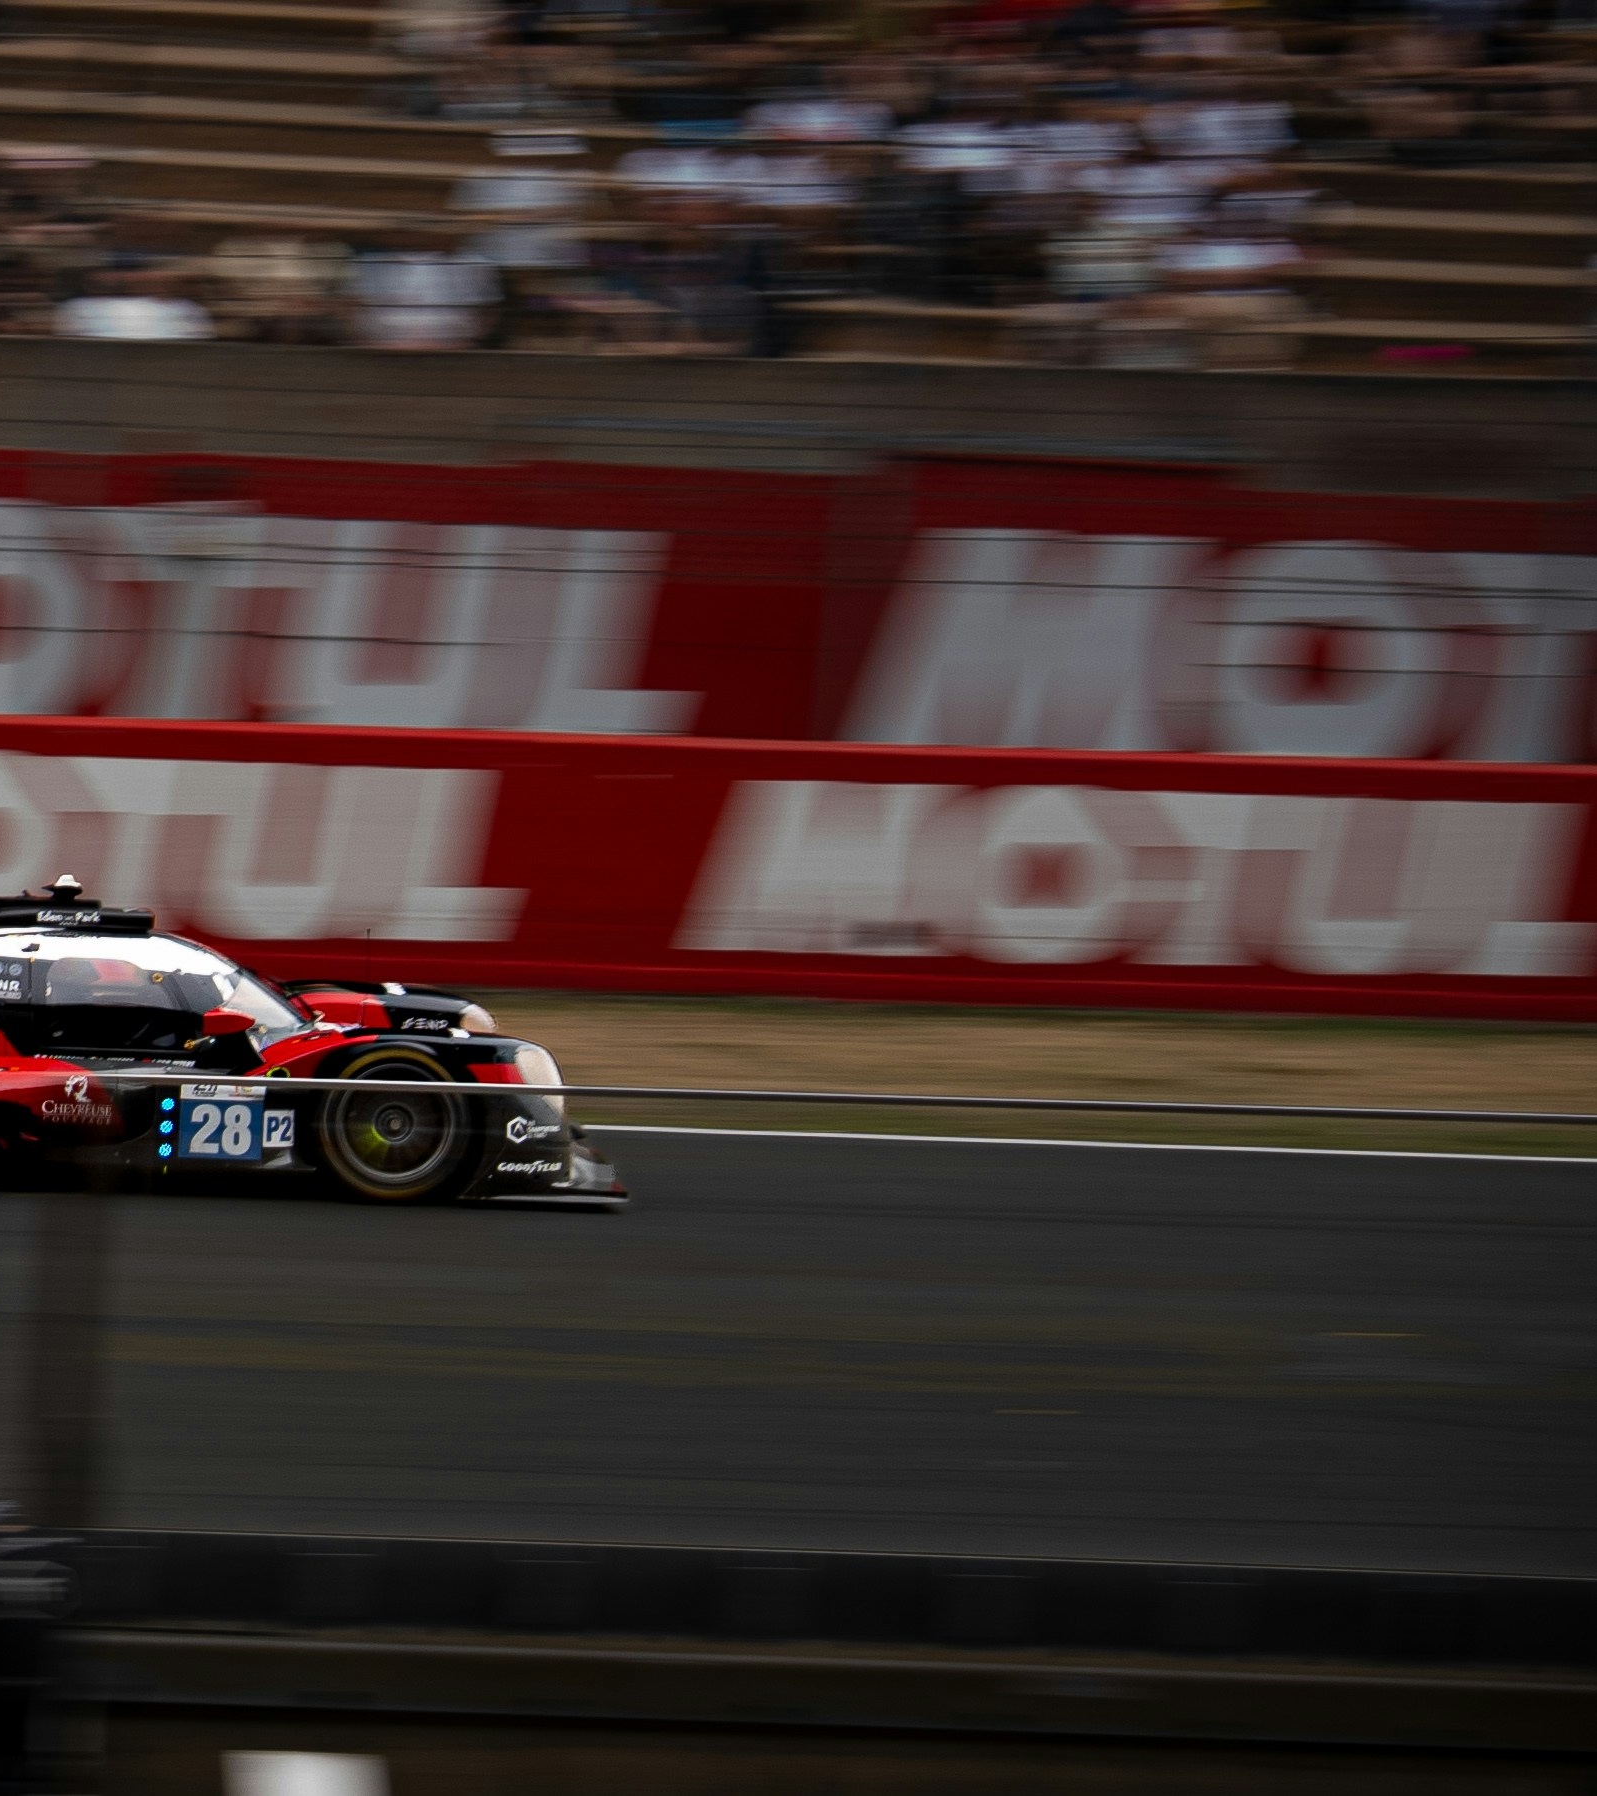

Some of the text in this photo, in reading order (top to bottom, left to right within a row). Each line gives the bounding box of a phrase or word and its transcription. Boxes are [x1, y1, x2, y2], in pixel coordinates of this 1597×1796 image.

[671, 780, 1597, 977] MOTUL
[188, 1103, 252, 1156] 28
[266, 1115, 292, 1143] P2
